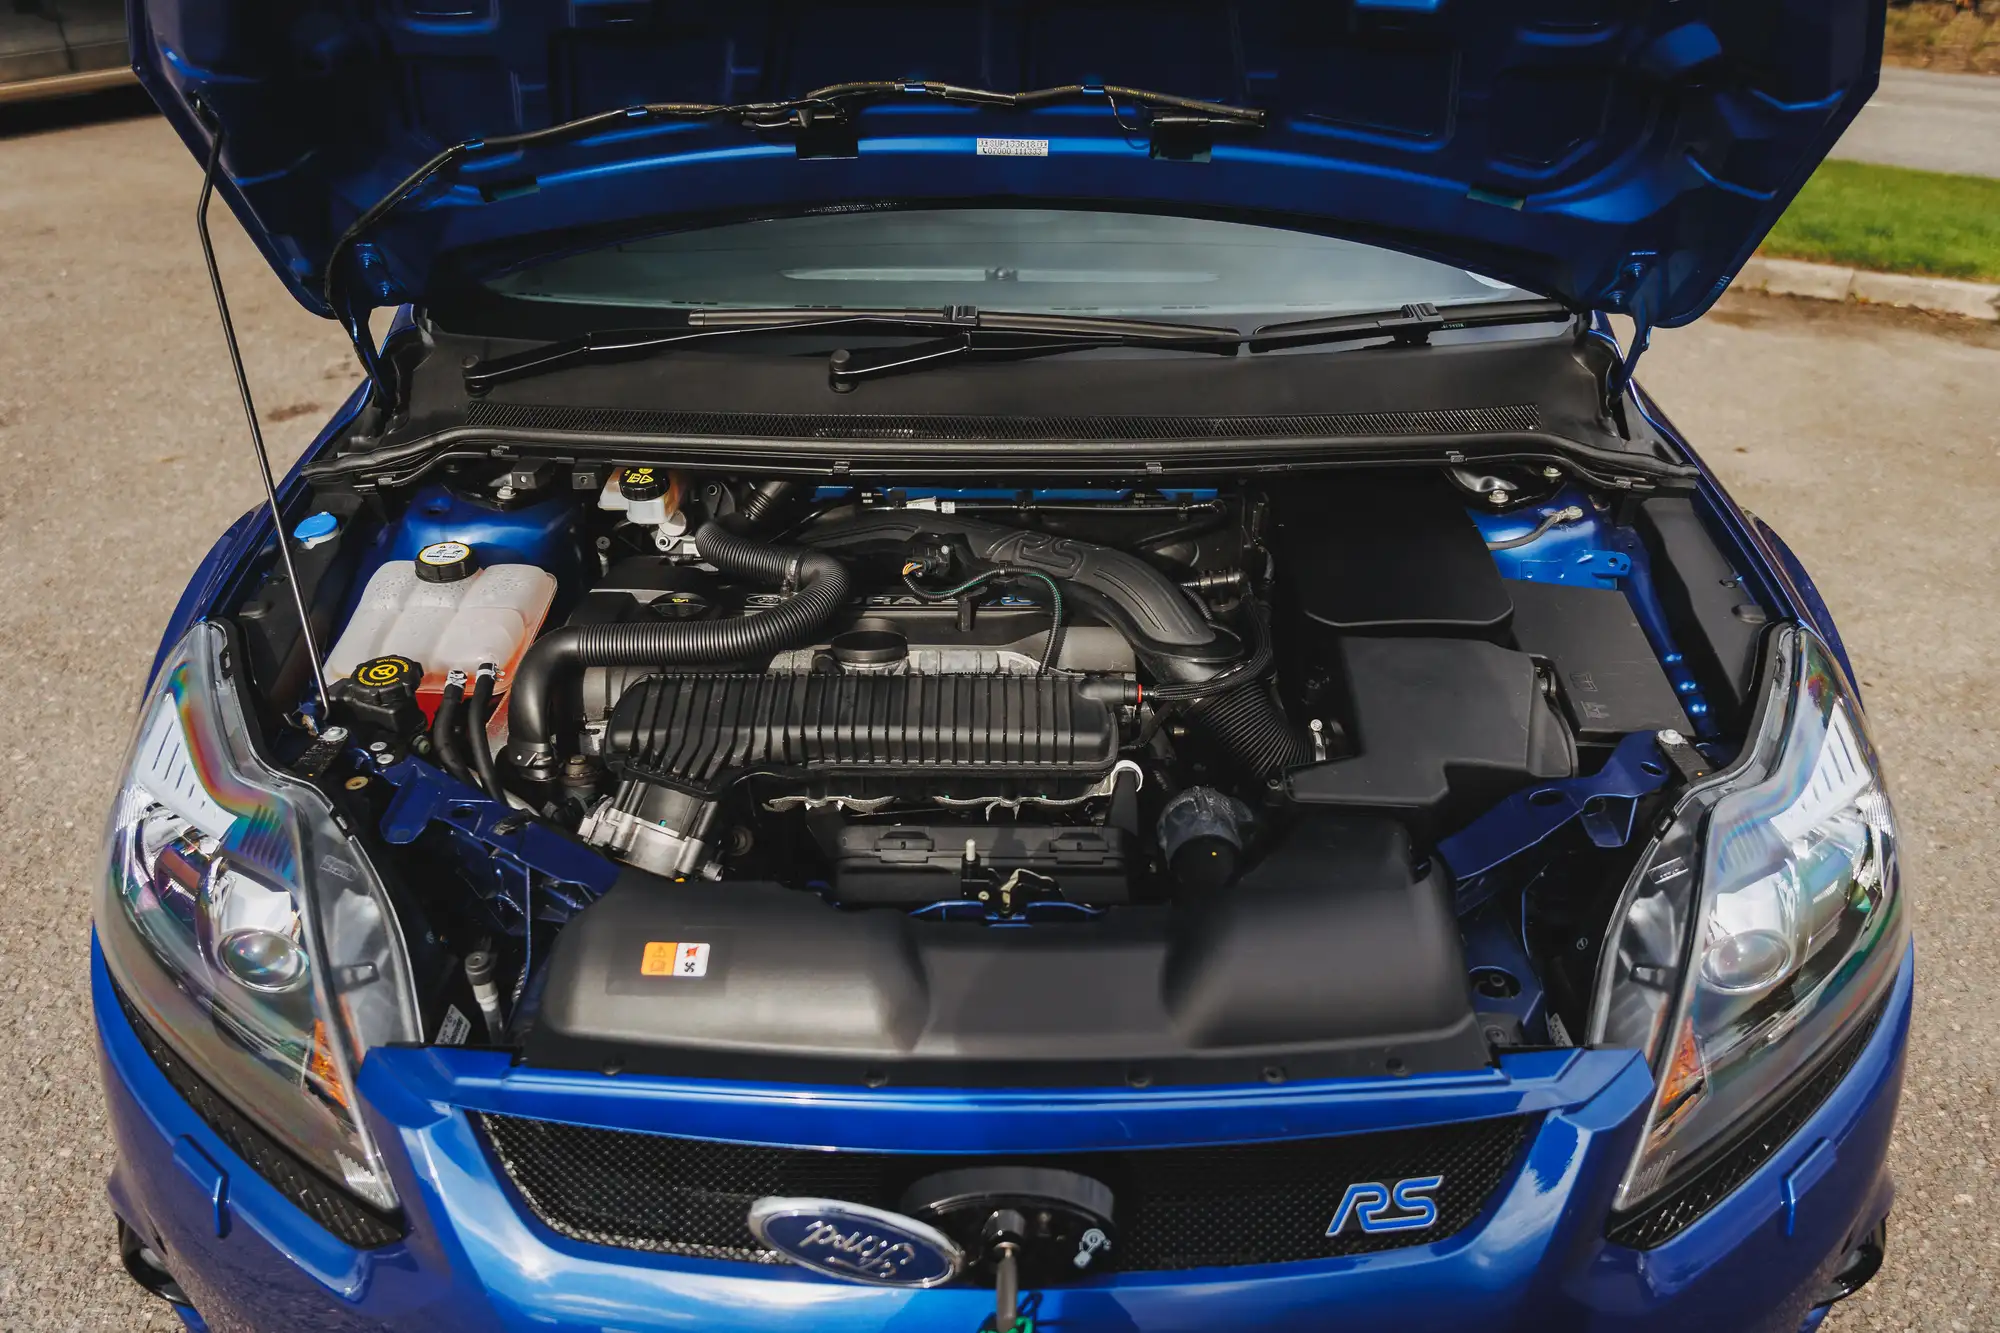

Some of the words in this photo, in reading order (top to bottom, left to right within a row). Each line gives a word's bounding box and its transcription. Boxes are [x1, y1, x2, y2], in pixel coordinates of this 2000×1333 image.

[988, 147, 1011, 155] 07000
[1015, 148, 1042, 156] 111333
[1325, 1175, 1444, 1237] RS
[798, 1219, 916, 1279] Ford
